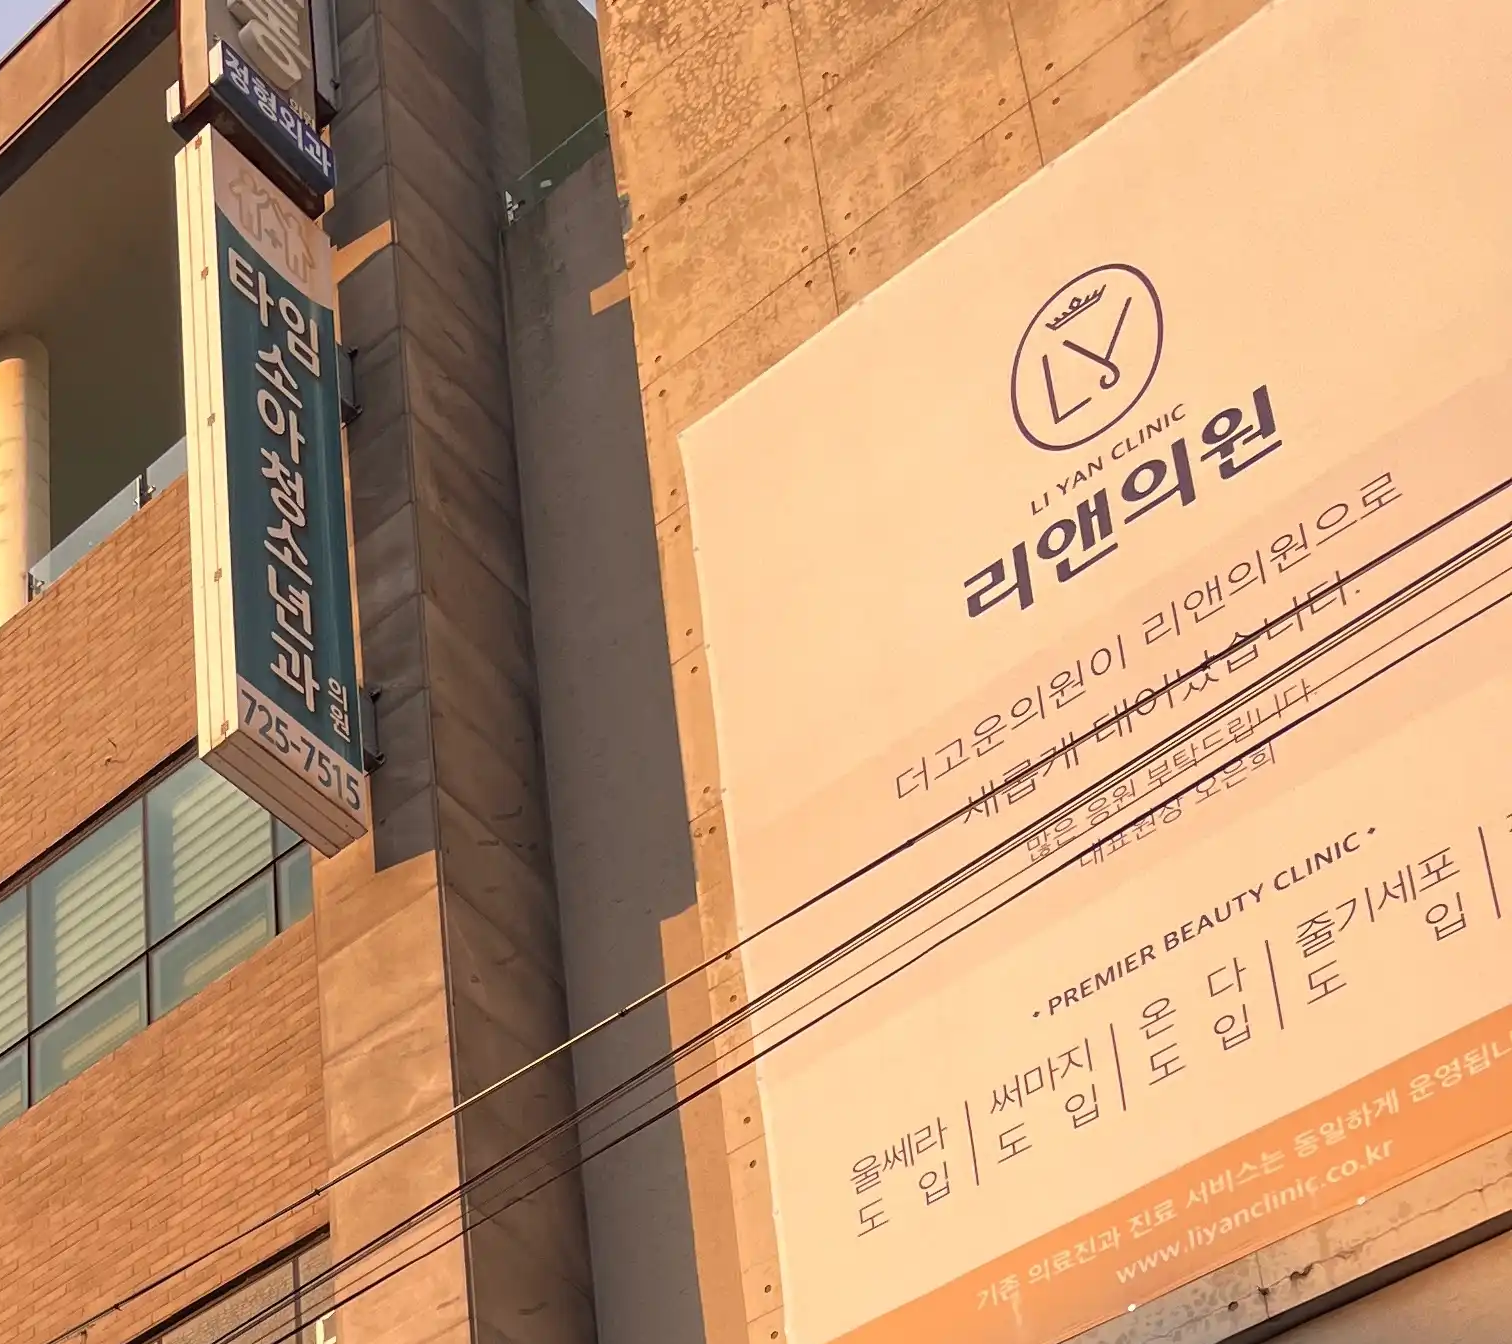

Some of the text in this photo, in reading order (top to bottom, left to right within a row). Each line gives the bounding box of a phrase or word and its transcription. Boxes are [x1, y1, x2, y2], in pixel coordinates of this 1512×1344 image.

[225, 48, 332, 178] 정형외과
[226, 243, 321, 379] 타임
[962, 383, 1285, 619] 리앤의원
[1029, 402, 1188, 517] LI YAN CLINIC
[253, 342, 322, 716] 소아청소년과
[894, 470, 1405, 802] 더고운의원이 리앤의원으로
[240, 687, 362, 811] 725-7515
[326, 674, 353, 745] 의원
[962, 731, 1082, 826] 새롭게
[1086, 777, 1138, 829] 응원
[1047, 830, 1362, 1020] PREMIER BEAUTY CLINIC
[1295, 846, 1461, 959] 줄기세포
[987, 1037, 1095, 1116] 써마지
[848, 1115, 950, 1194] 울쎄라
[1028, 1227, 1122, 1284] 의료진과
[1128, 1200, 1178, 1241] 진료
[1184, 1146, 1287, 1209] 서비스는
[1291, 1087, 1401, 1160] 동일하게
[1114, 1135, 1394, 1286] www.liyanclinic.co.kr
